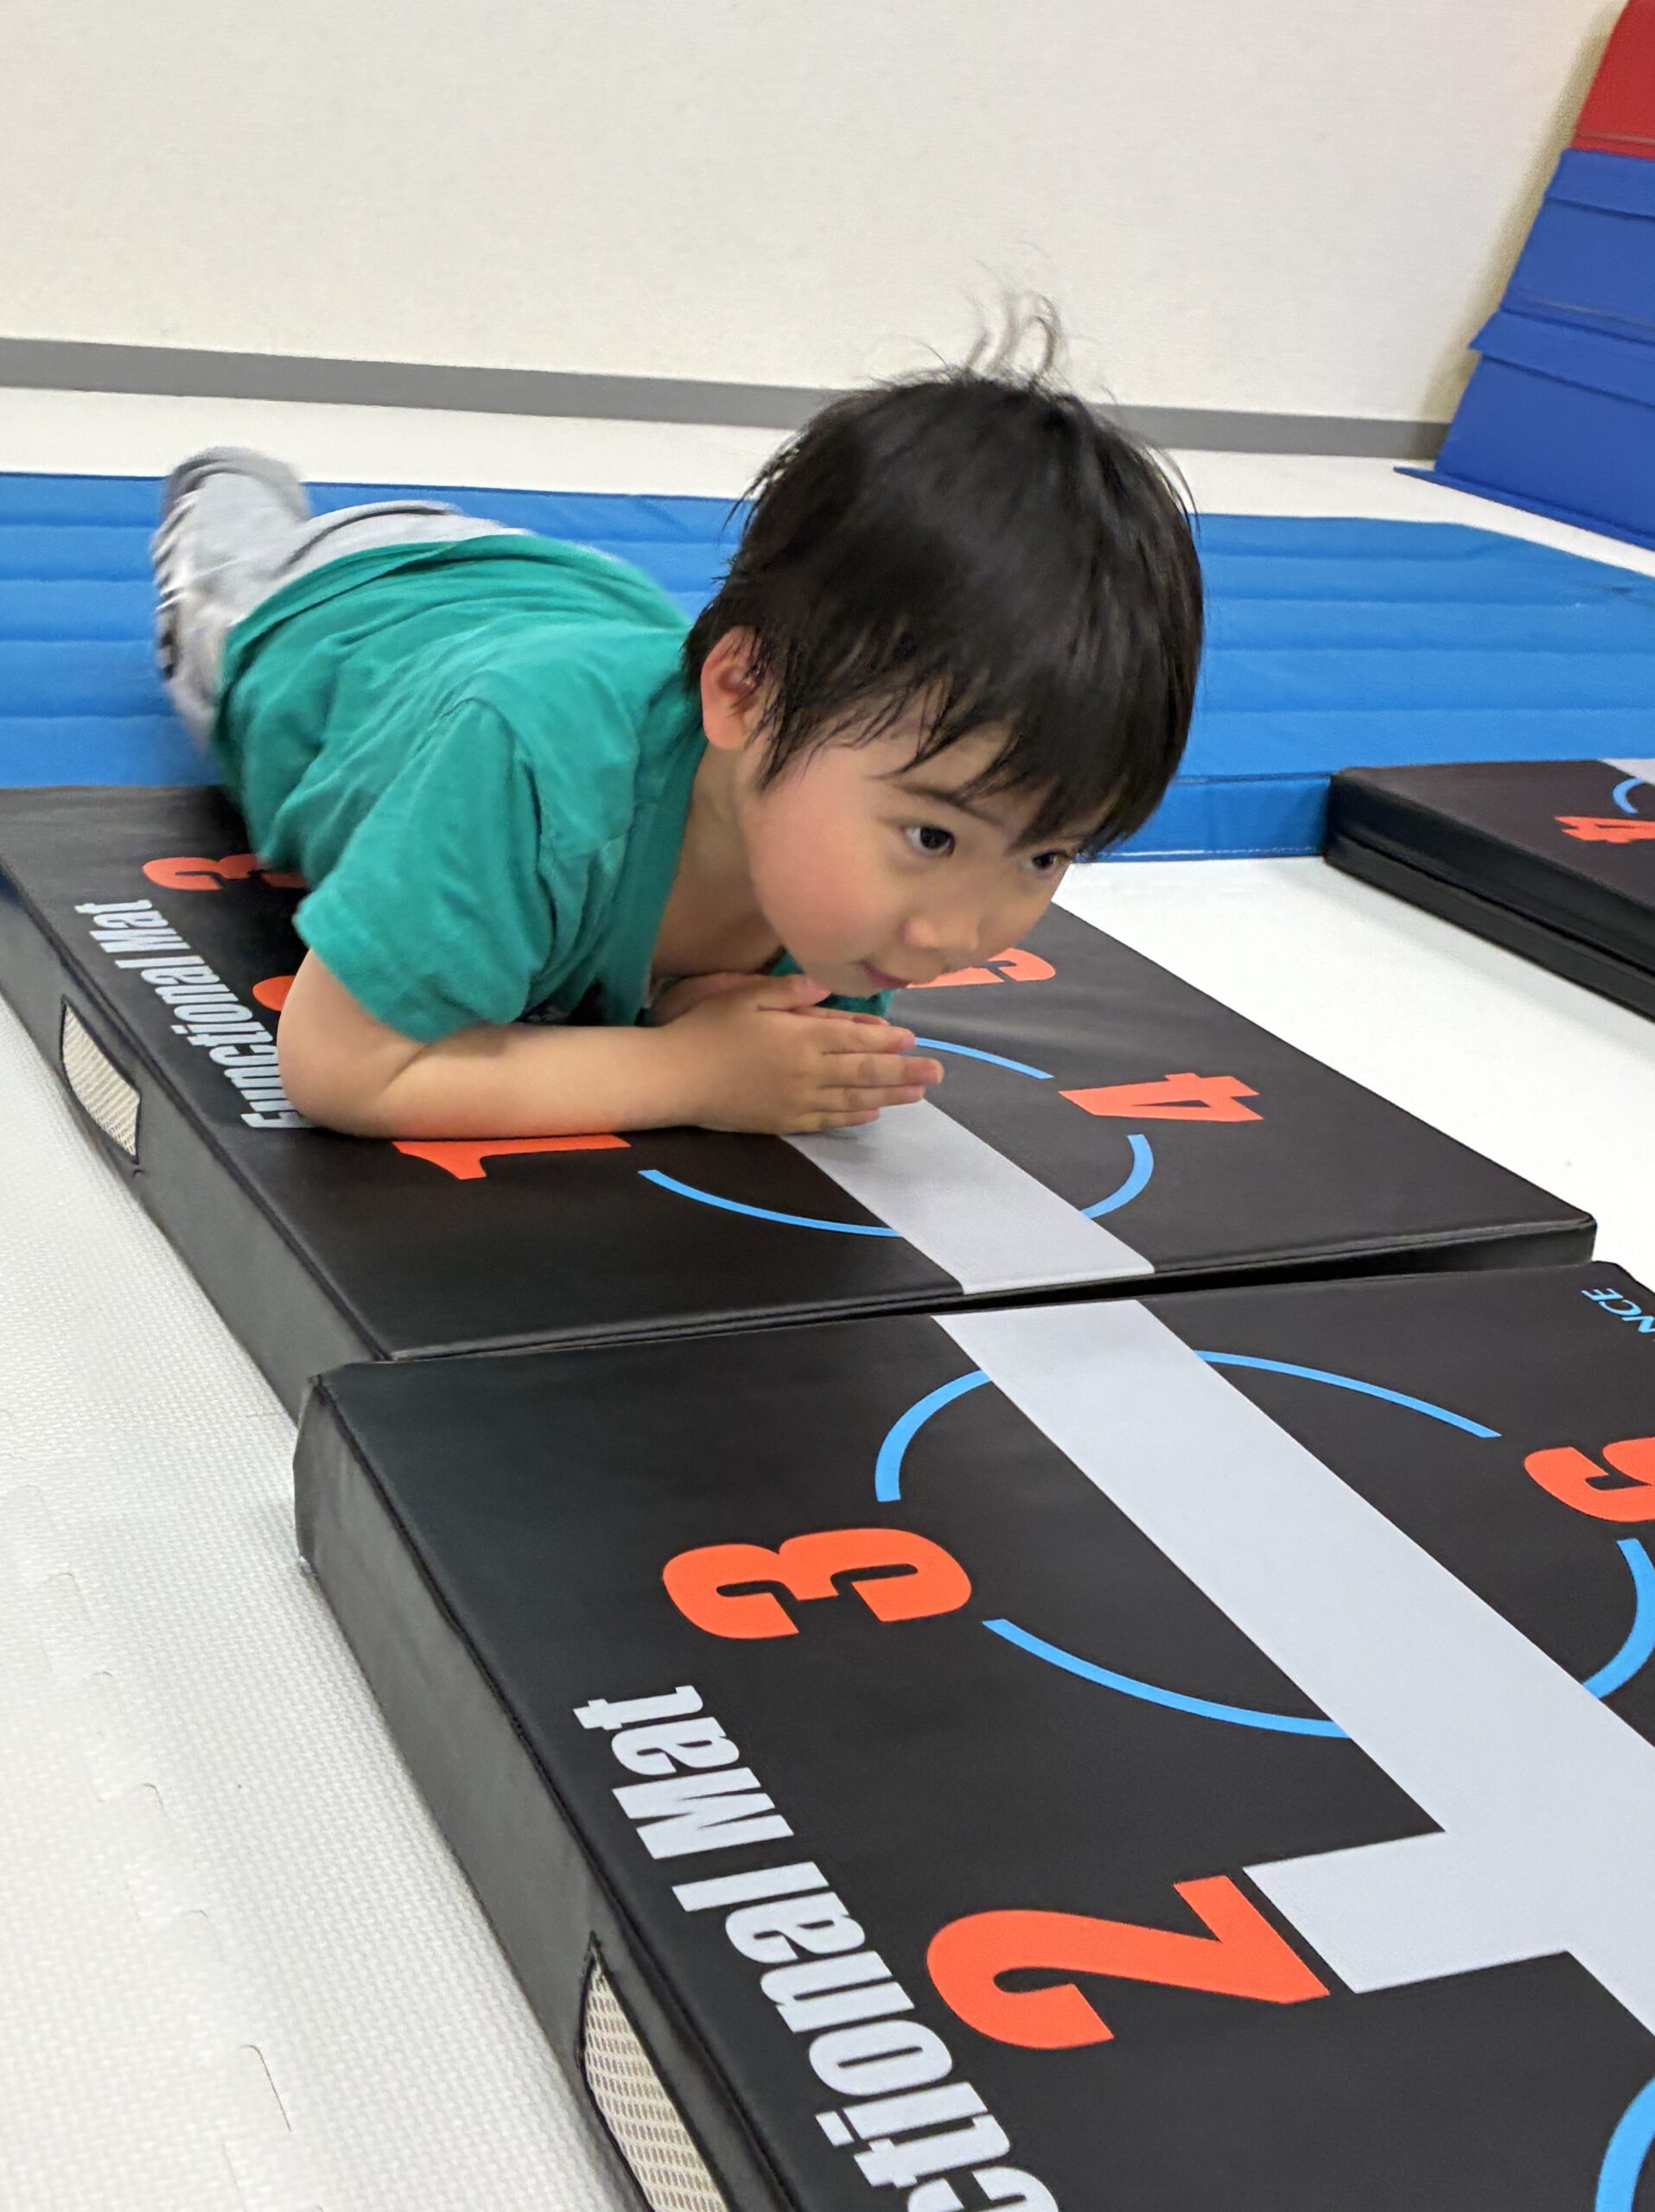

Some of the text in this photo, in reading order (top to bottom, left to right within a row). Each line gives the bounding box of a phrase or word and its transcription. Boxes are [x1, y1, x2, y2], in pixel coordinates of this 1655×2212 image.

[73, 899, 191, 954] Mat
[1059, 1072, 1264, 1123] 4
[391, 1134, 632, 1180] 1
[662, 1527, 972, 1640] 3
[572, 1685, 794, 1859] Mat
[926, 1875, 1330, 2050] 2
